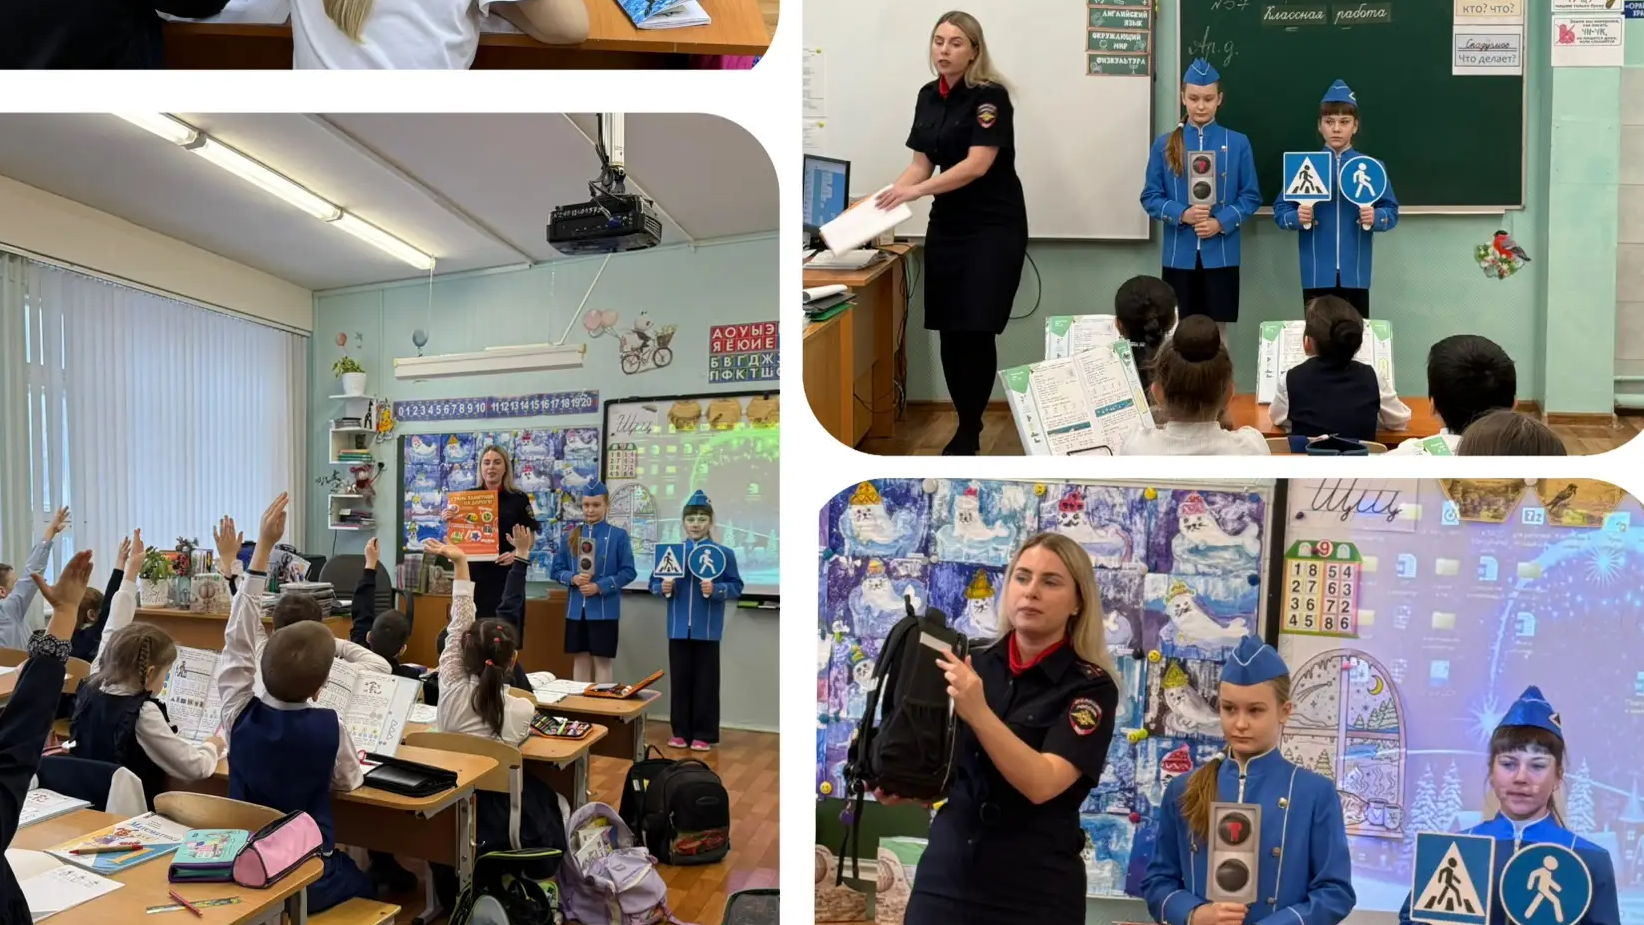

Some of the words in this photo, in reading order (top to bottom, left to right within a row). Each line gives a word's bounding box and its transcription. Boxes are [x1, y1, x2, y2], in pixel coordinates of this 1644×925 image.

[1102, 10, 1148, 18] АНГЛИЙСКИЙ
[1264, 5, 1324, 20] Классная
[1334, 3, 1387, 25] работа
[1462, 3, 1488, 13] кто?
[1490, 3, 1515, 13] что?
[1092, 32, 1142, 41] ОКРУЖАЮЩИЙ
[1096, 56, 1146, 65] ФИЗКУЛЬТУРА
[1459, 54, 1476, 63] Что
[1478, 54, 1516, 64] делает?
[491, 402, 499, 411] 11
[500, 402, 509, 411] 12
[510, 401, 519, 410] 13
[520, 401, 529, 410] 14
[530, 400, 539, 409] 15
[541, 400, 549, 409] 16
[550, 399, 559, 408] 17
[560, 398, 570, 408] 18
[571, 398, 580, 407] 19
[580, 397, 591, 406] 20
[1320, 541, 1329, 555] 9
[1295, 564, 1300, 575] 1
[1308, 564, 1317, 576] 8
[1328, 566, 1337, 578] 5
[1343, 566, 1352, 578] 4
[1292, 580, 1300, 593] 2
[1308, 580, 1317, 592] 7
[1328, 582, 1336, 594] 6
[1343, 583, 1352, 596] 3
[1291, 597, 1299, 610] 3
[1306, 598, 1315, 611] 6
[1327, 600, 1335, 612] 7
[1341, 600, 1350, 613] 2
[1289, 615, 1298, 626] 4
[1305, 615, 1313, 627] 5
[1325, 617, 1333, 630] 8
[1340, 617, 1349, 629] 6
